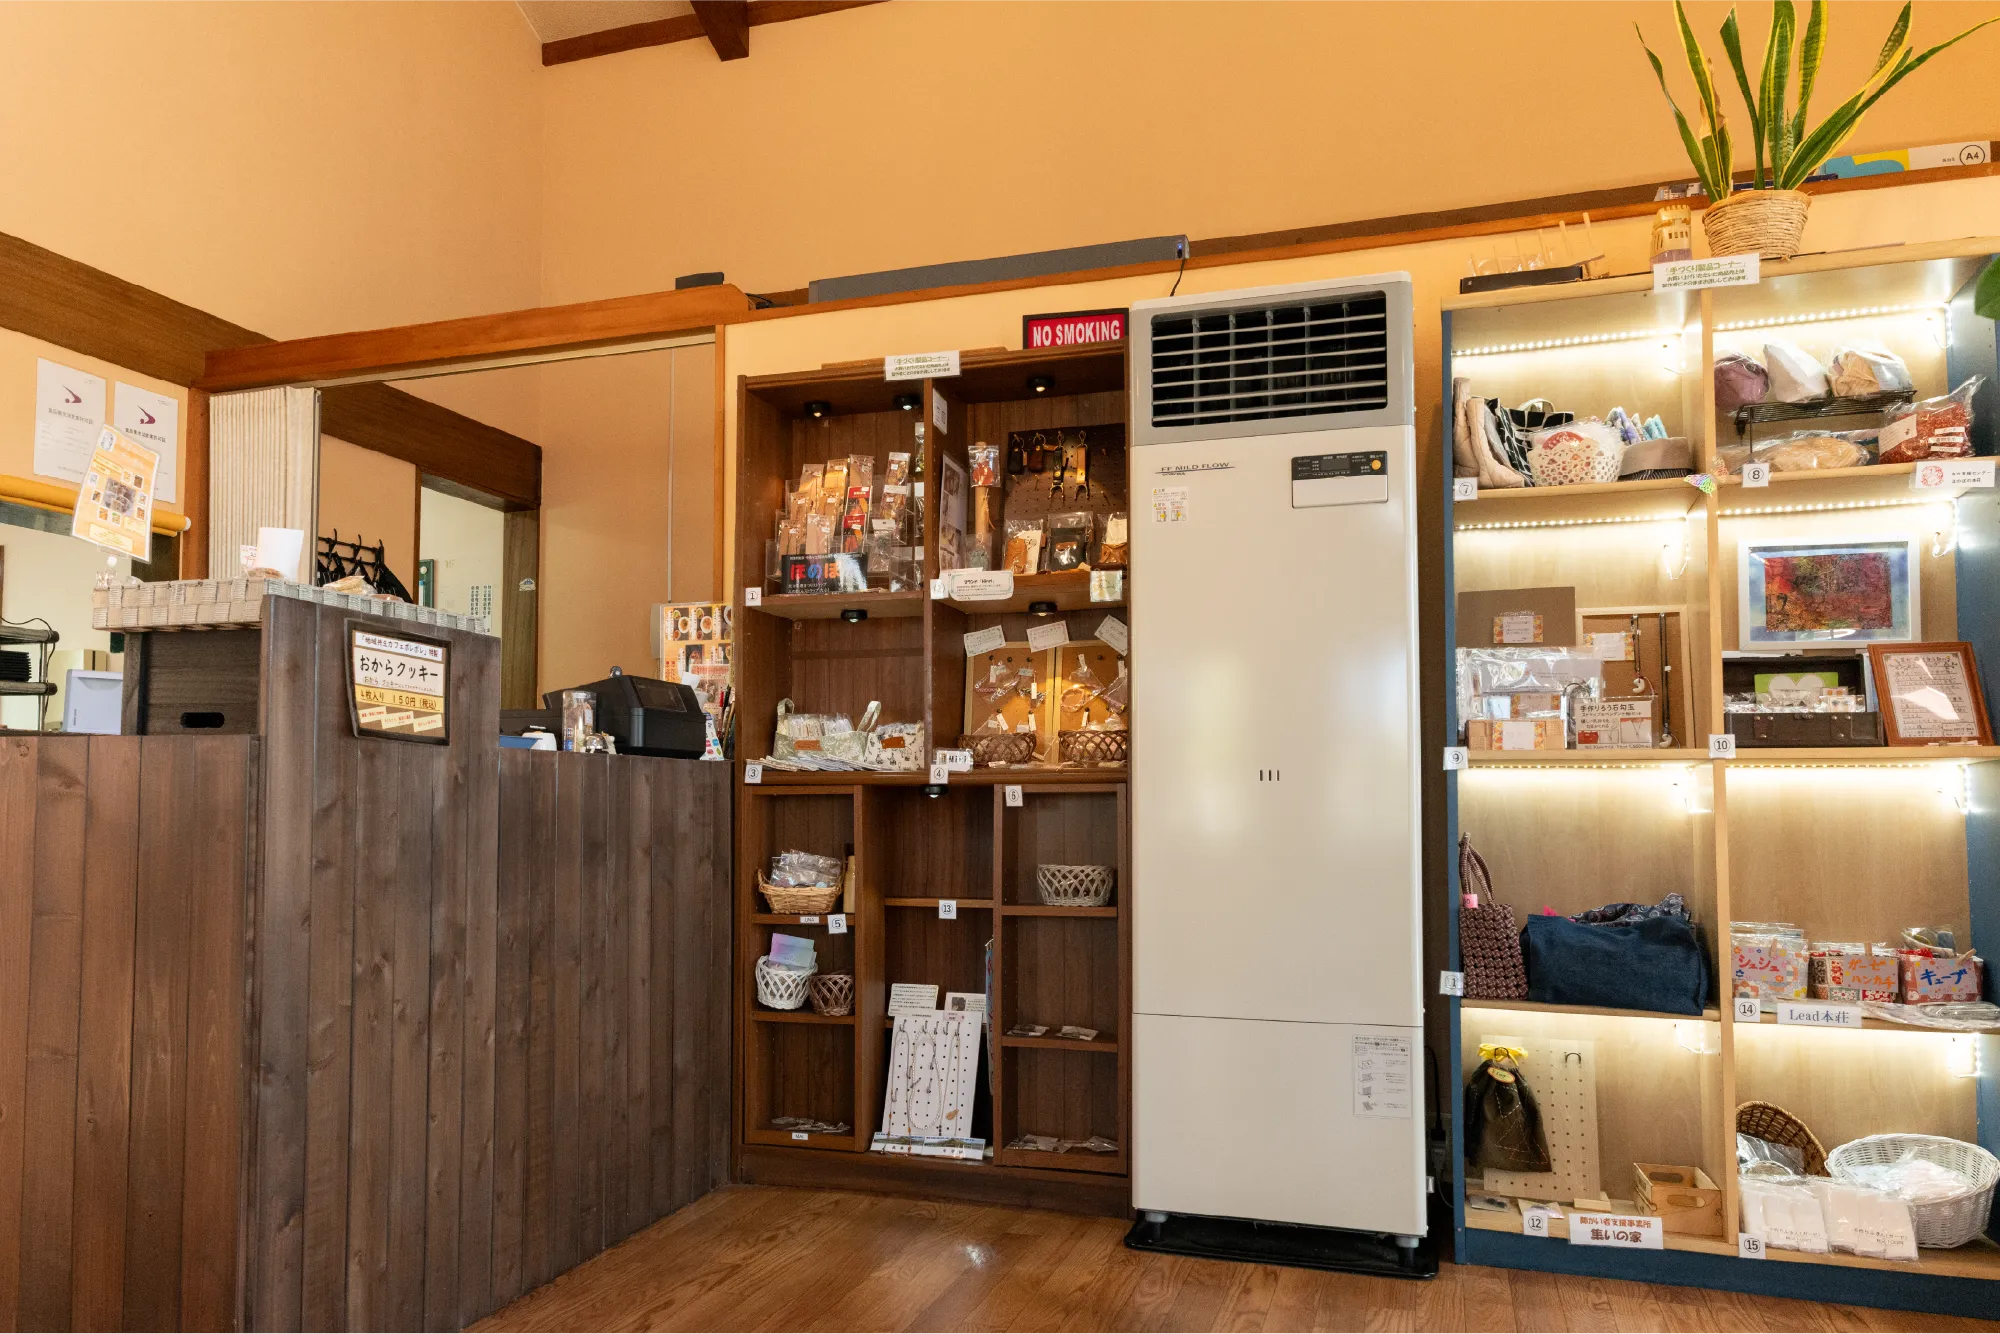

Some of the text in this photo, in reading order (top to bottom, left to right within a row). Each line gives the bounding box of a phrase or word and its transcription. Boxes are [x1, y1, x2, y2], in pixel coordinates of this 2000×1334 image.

[1966, 152, 1980, 160] A4
[1033, 319, 1121, 347] NO SMOKING
[360, 654, 439, 682] おからクッキー
[1738, 955, 1780, 972] シュシュ
[1848, 959, 1887, 971] ガーゼ
[1851, 974, 1896, 990] ハンカチ
[1920, 968, 1968, 986] キューブ
[1789, 1008, 1849, 1024] Lead本荘
[1580, 1216, 1652, 1229] 障がい者支援事業所
[1590, 1228, 1642, 1243] 集いの家
